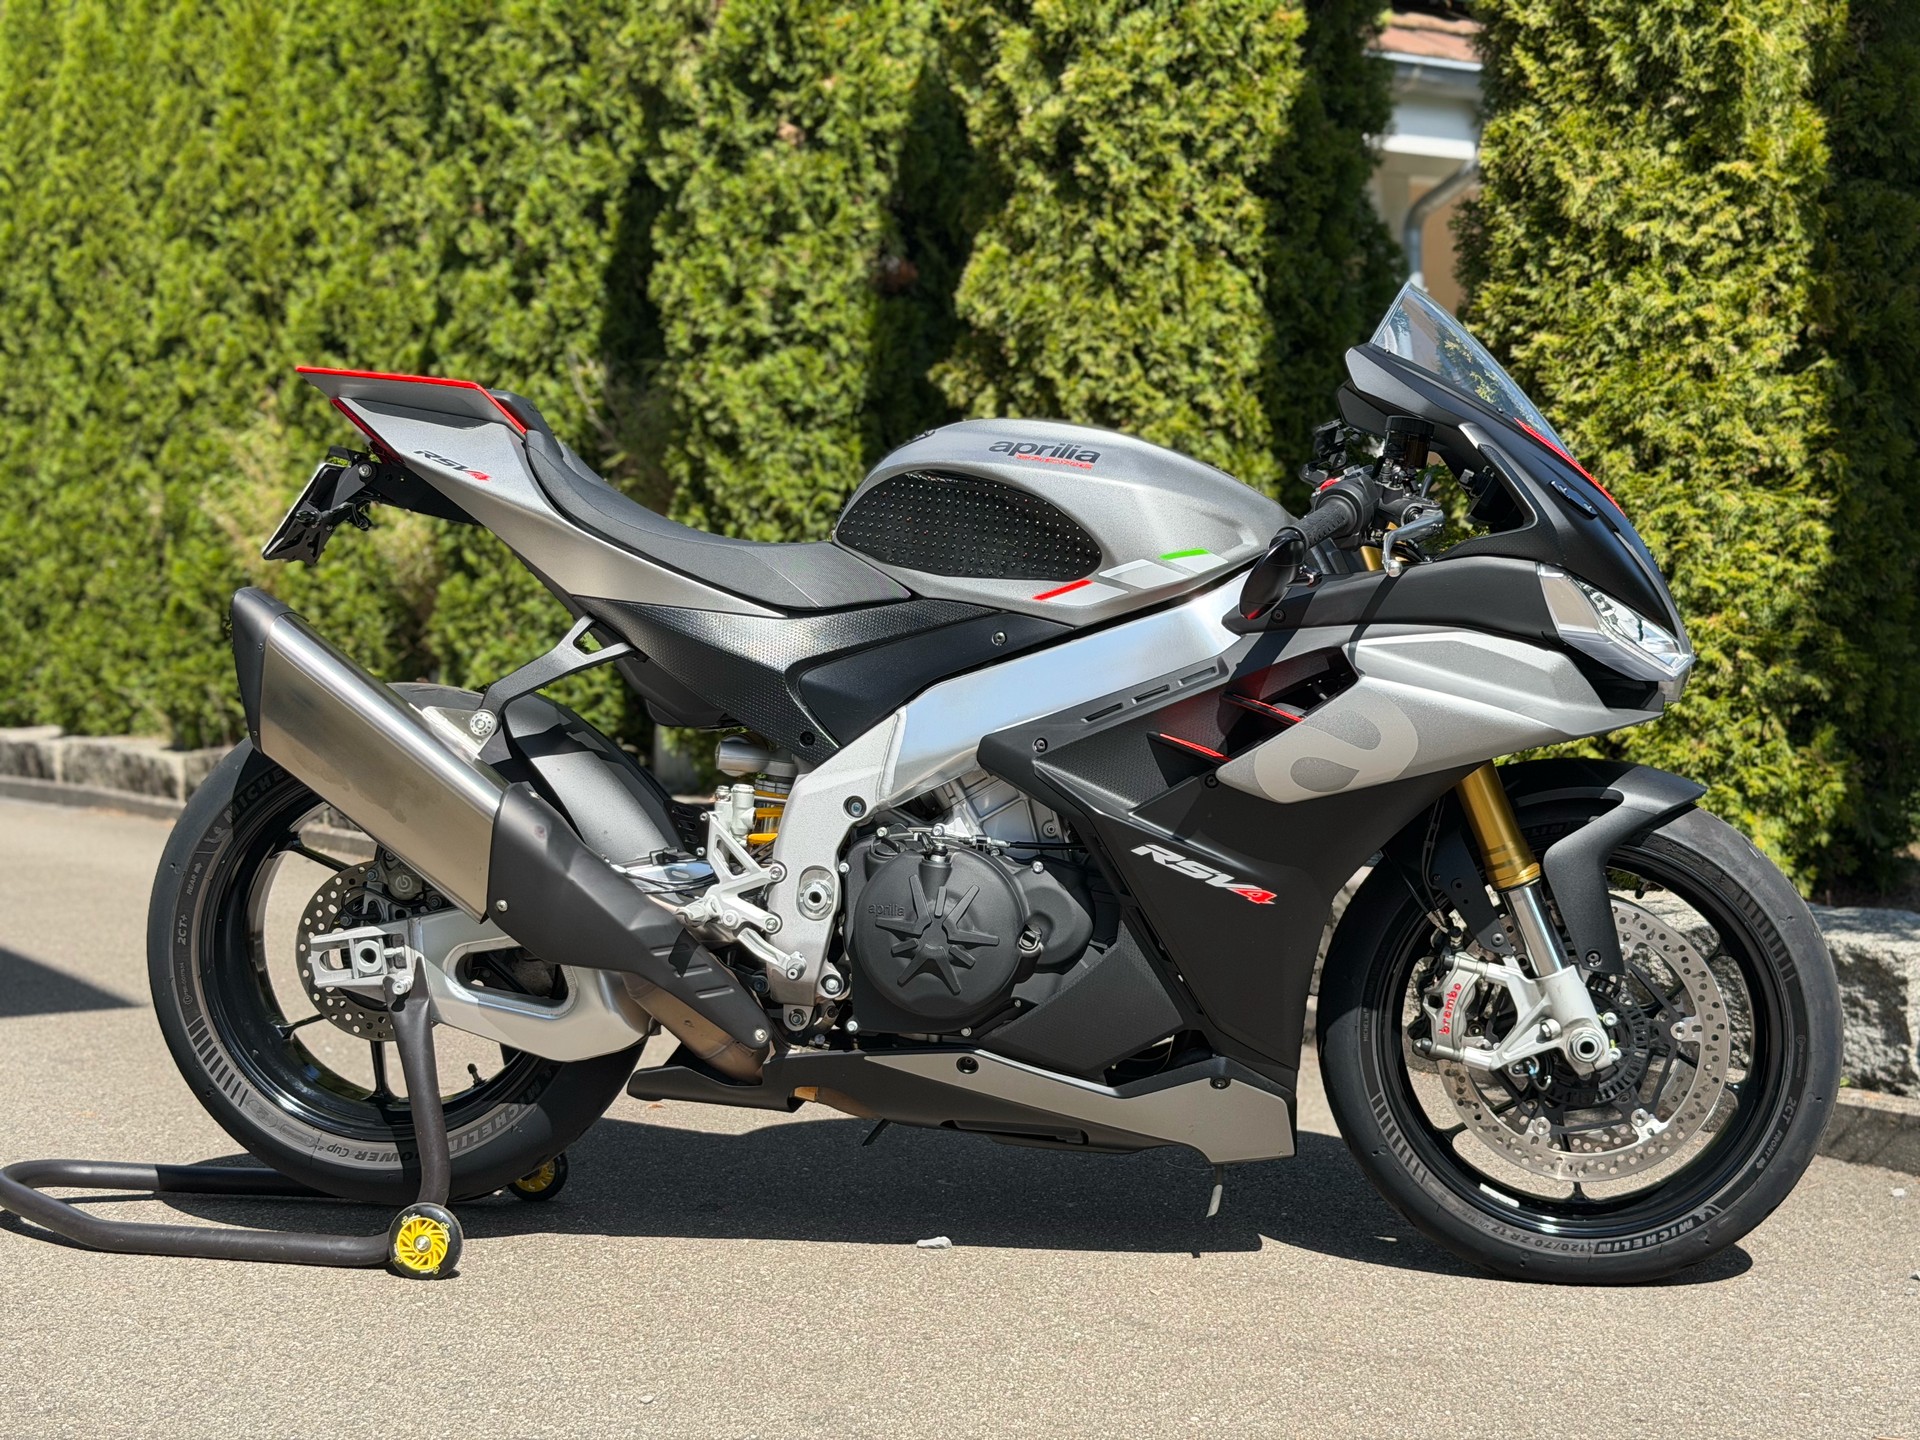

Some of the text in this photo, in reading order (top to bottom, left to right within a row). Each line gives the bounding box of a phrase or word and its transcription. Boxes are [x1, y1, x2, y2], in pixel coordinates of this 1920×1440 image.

[413, 450, 492, 481] RSV4
[988, 441, 1101, 463] aprilia
[223, 769, 285, 823] MICHE
[187, 874, 198, 895] REAR
[1130, 844, 1278, 905] RSV4
[868, 903, 905, 918] aprilia
[178, 914, 188, 945] 2CT+
[1438, 983, 1461, 1034] brembo
[1764, 1096, 1797, 1159] 2CT FRONT
[354, 1149, 419, 1163] OWER
[1510, 1232, 1531, 1244] ZR
[1534, 1240, 1589, 1253] 120/70
[1598, 1218, 1695, 1253] MICHELIN
